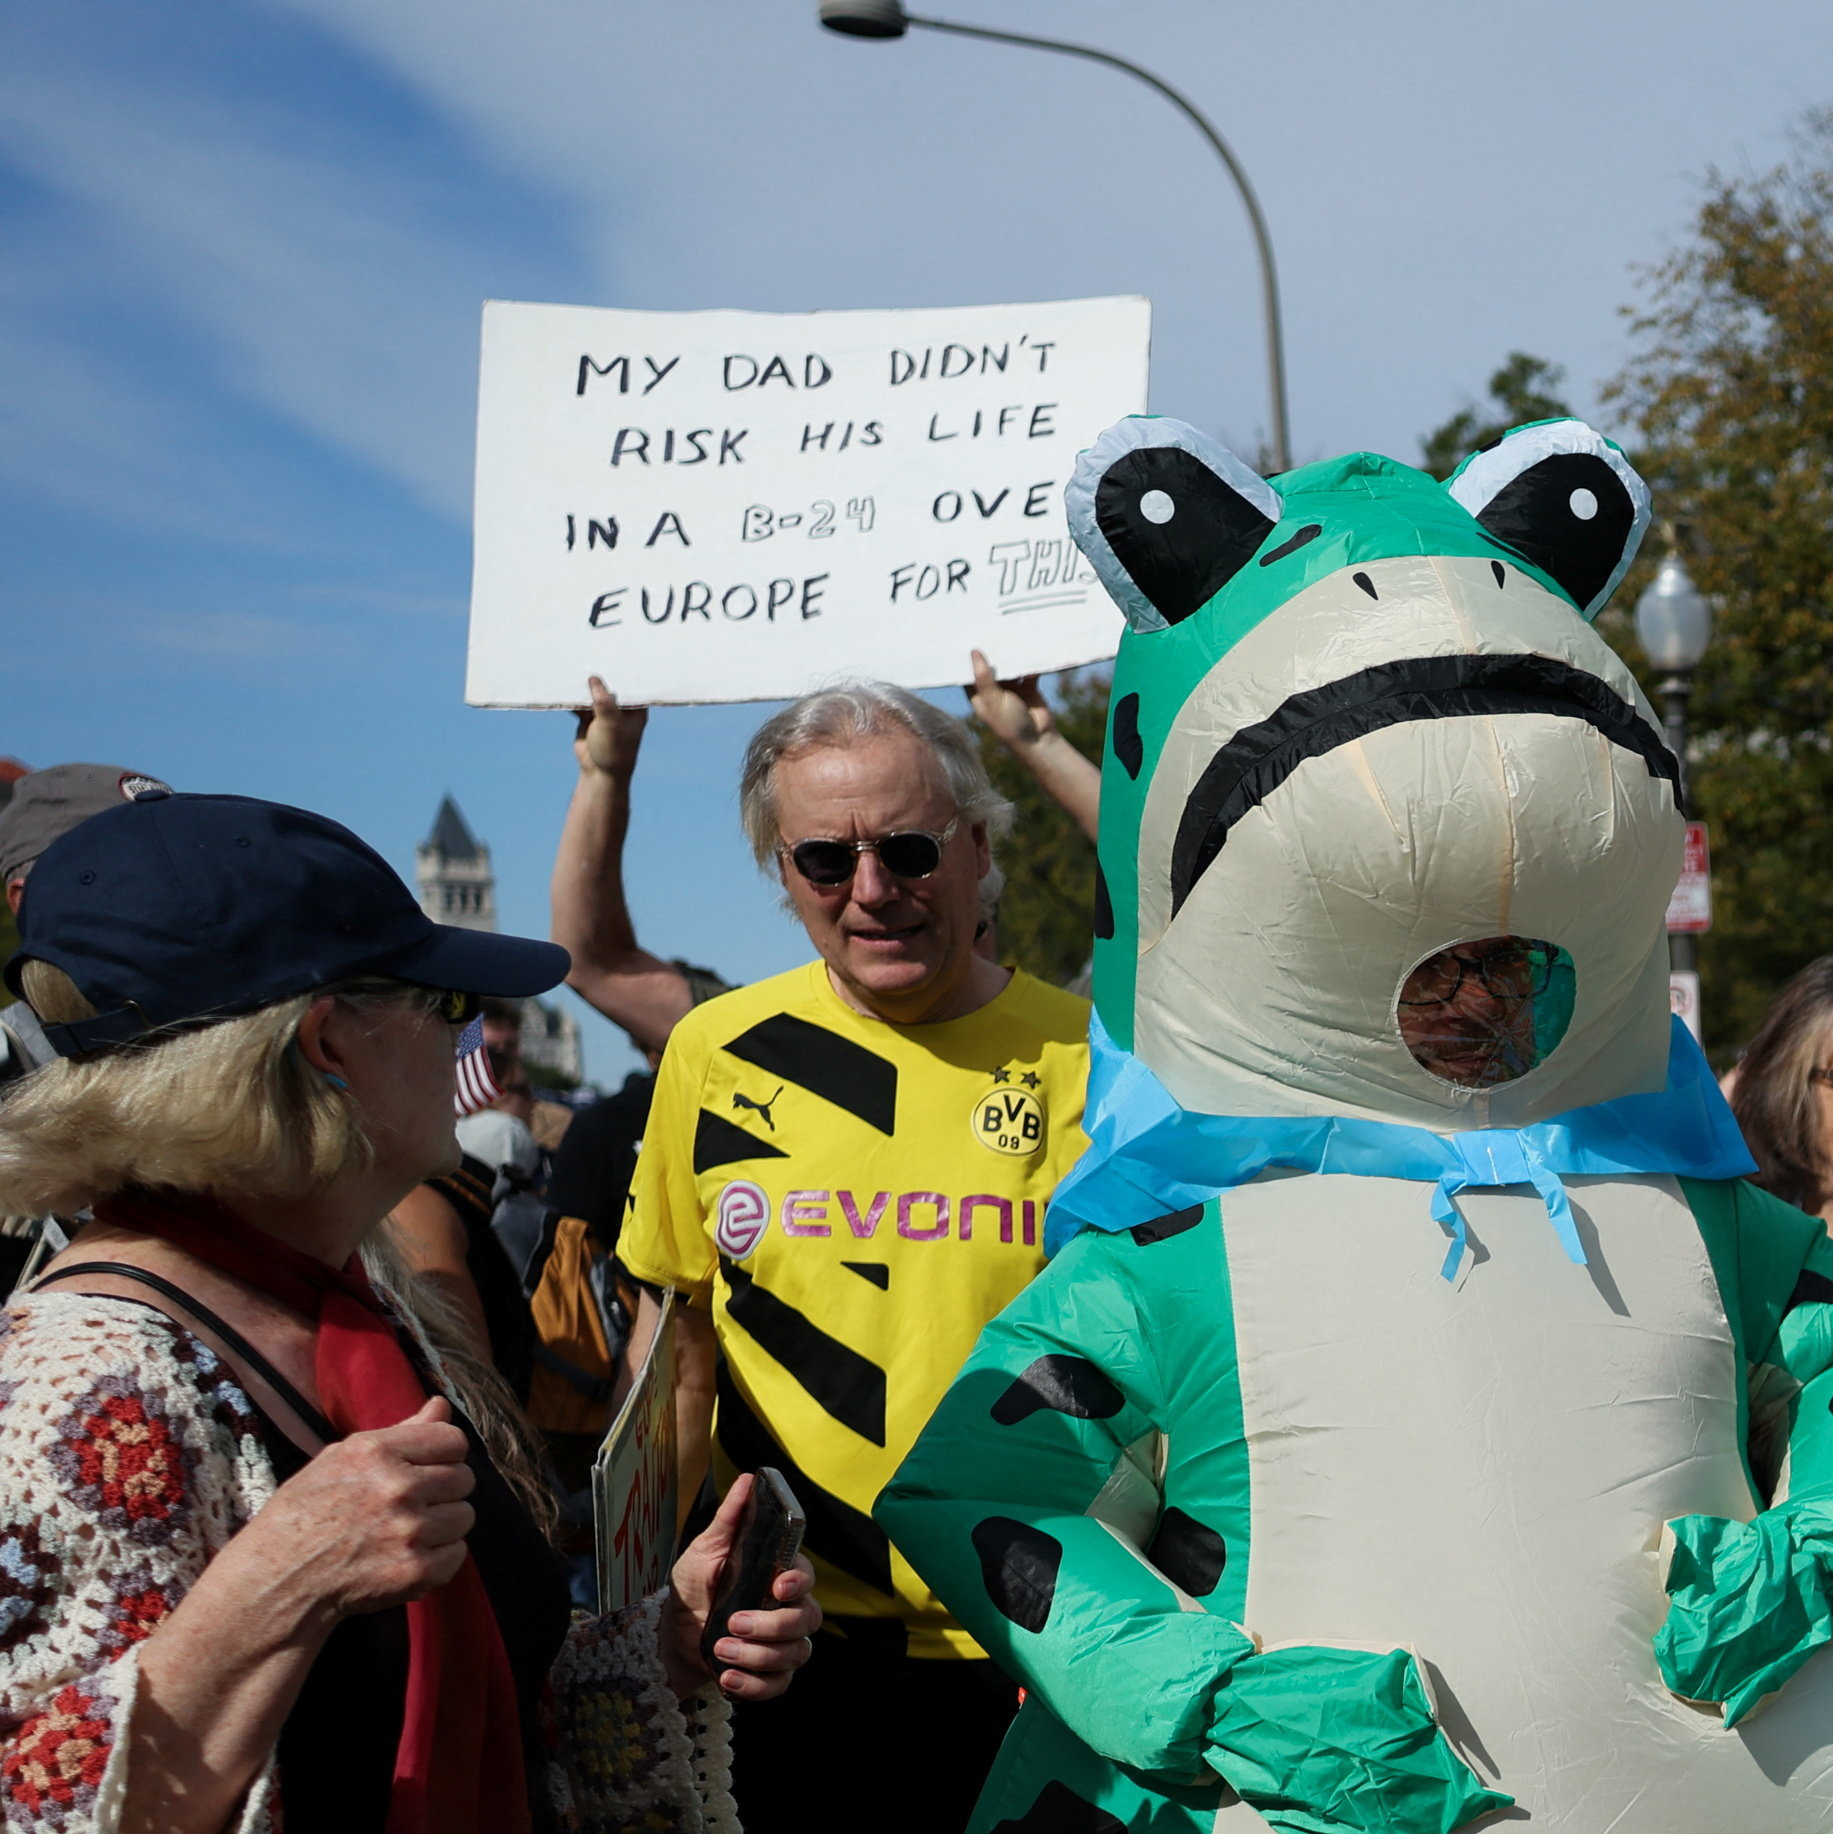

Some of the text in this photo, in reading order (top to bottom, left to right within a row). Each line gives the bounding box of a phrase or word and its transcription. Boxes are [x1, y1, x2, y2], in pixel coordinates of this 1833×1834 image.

[575, 333, 1057, 398] MY DAD DIDN'T
[609, 402, 1060, 469] RISK HIS LIFE
[564, 479, 1056, 554] IN A B-24 OVE
[587, 571, 831, 631] EUROPE
[889, 557, 973, 605] FOR
[982, 1093, 1042, 1141] BVB
[997, 1133, 1020, 1151] 09
[780, 1189, 1052, 1246] EVONI
